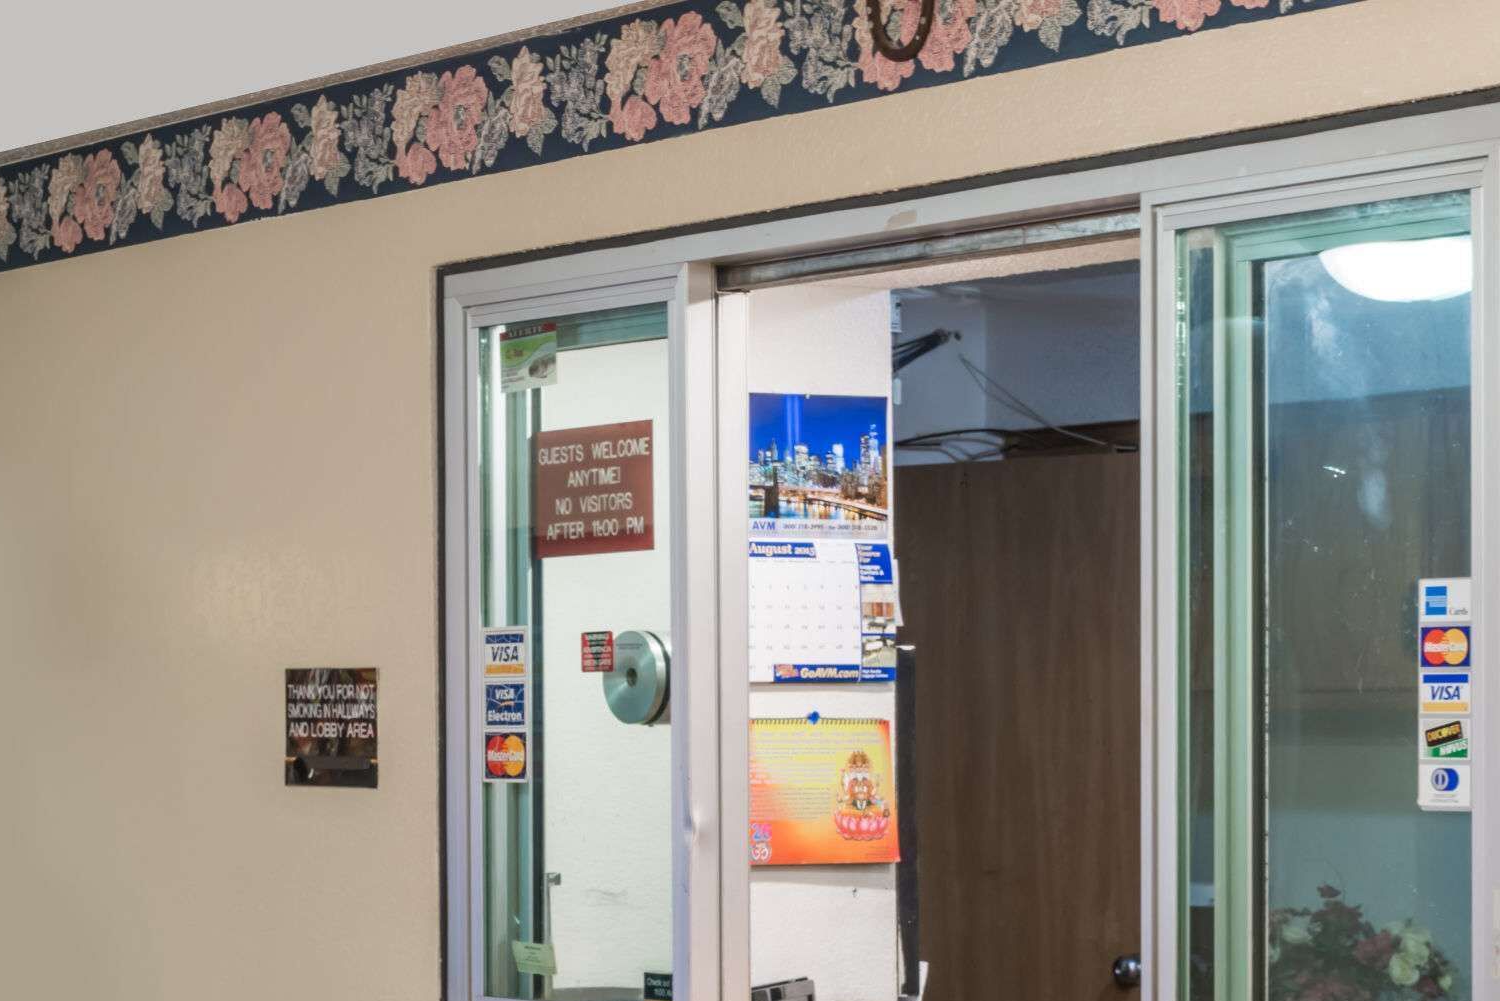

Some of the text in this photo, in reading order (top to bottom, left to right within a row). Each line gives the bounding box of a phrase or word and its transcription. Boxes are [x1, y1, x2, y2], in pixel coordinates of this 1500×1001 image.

[538, 436, 650, 465] GUESTS WELCOME
[555, 491, 633, 515] NO VISITORS
[546, 520, 585, 541] AFTER
[626, 516, 645, 535] PM
[752, 521, 776, 531] AVM
[749, 543, 792, 557] August
[491, 645, 519, 662] VISA
[801, 668, 859, 679] GoAVM.com
[287, 684, 375, 700] THANK YOU FOR NOT
[495, 688, 514, 700] VISA
[1431, 685, 1461, 700] VISA
[288, 703, 322, 718] SMOKING
[332, 703, 375, 719] HALLWAYS
[488, 710, 522, 722] Electron
[289, 722, 374, 738] AND LOBBY AREA
